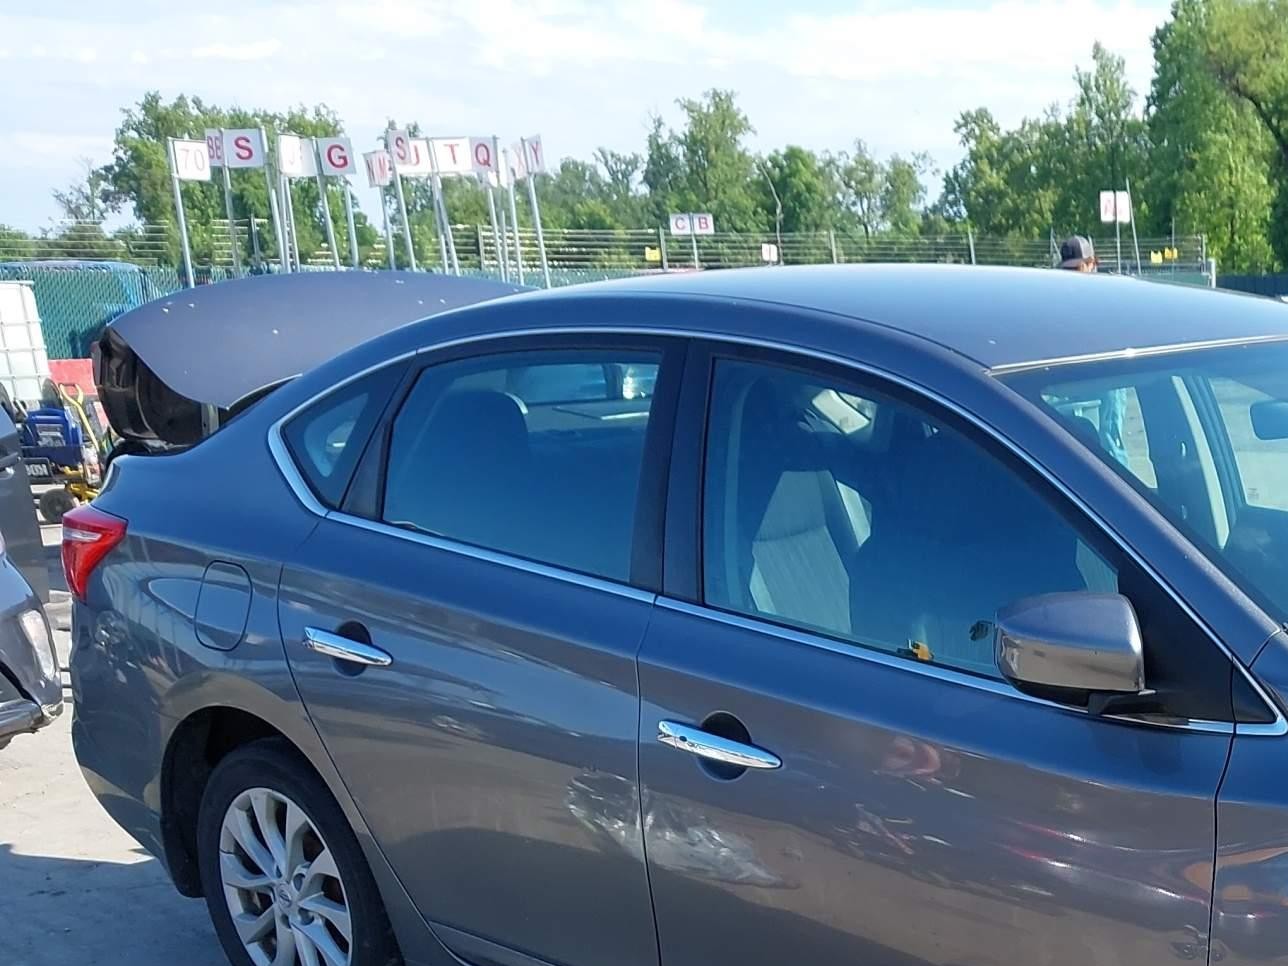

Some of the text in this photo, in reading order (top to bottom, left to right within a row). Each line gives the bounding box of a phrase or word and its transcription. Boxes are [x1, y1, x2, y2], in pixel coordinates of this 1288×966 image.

[234, 136, 253, 160] S
[327, 144, 349, 169] G
[395, 136, 407, 161] S
[443, 143, 460, 165] T
[475, 143, 491, 168] Q
[675, 217, 686, 230] C
[698, 216, 709, 230] B
